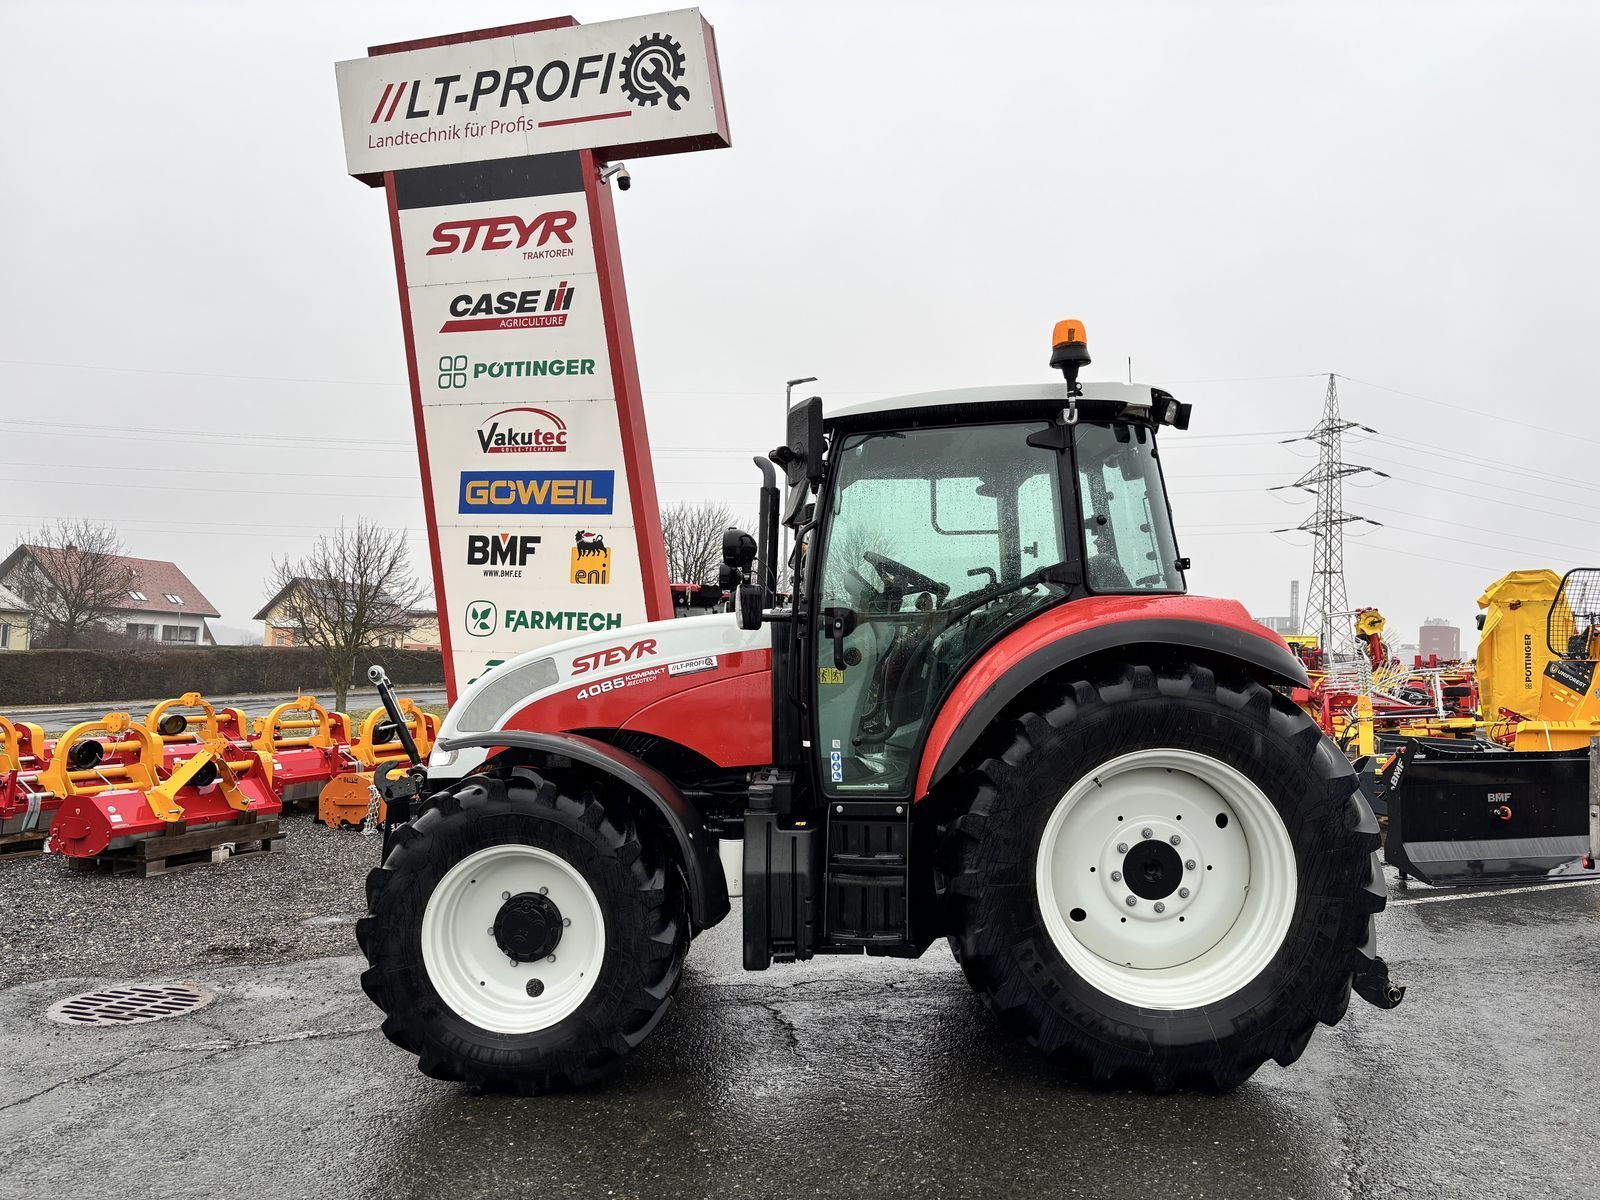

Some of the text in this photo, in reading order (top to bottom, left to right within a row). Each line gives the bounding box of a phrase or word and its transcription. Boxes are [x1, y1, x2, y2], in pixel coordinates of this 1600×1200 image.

[368, 116, 534, 149] Landtechnik für Profis
[425, 210, 577, 256] STEYR
[522, 248, 574, 260] TRAKTOREN
[449, 290, 541, 317] CASE
[500, 316, 563, 328] AGRICULTURE
[477, 422, 567, 453] Vakutec
[467, 535, 541, 566] BMF
[575, 563, 606, 584] eni
[505, 610, 622, 632] FARMTECH
[571, 639, 657, 676] STEYR
[625, 667, 666, 681] KOMPAKT
[1557, 669, 1586, 688] UNIFOREST
[576, 677, 625, 700] 4085
[1390, 758, 1404, 786] BMF
[1488, 793, 1511, 802] BMF
